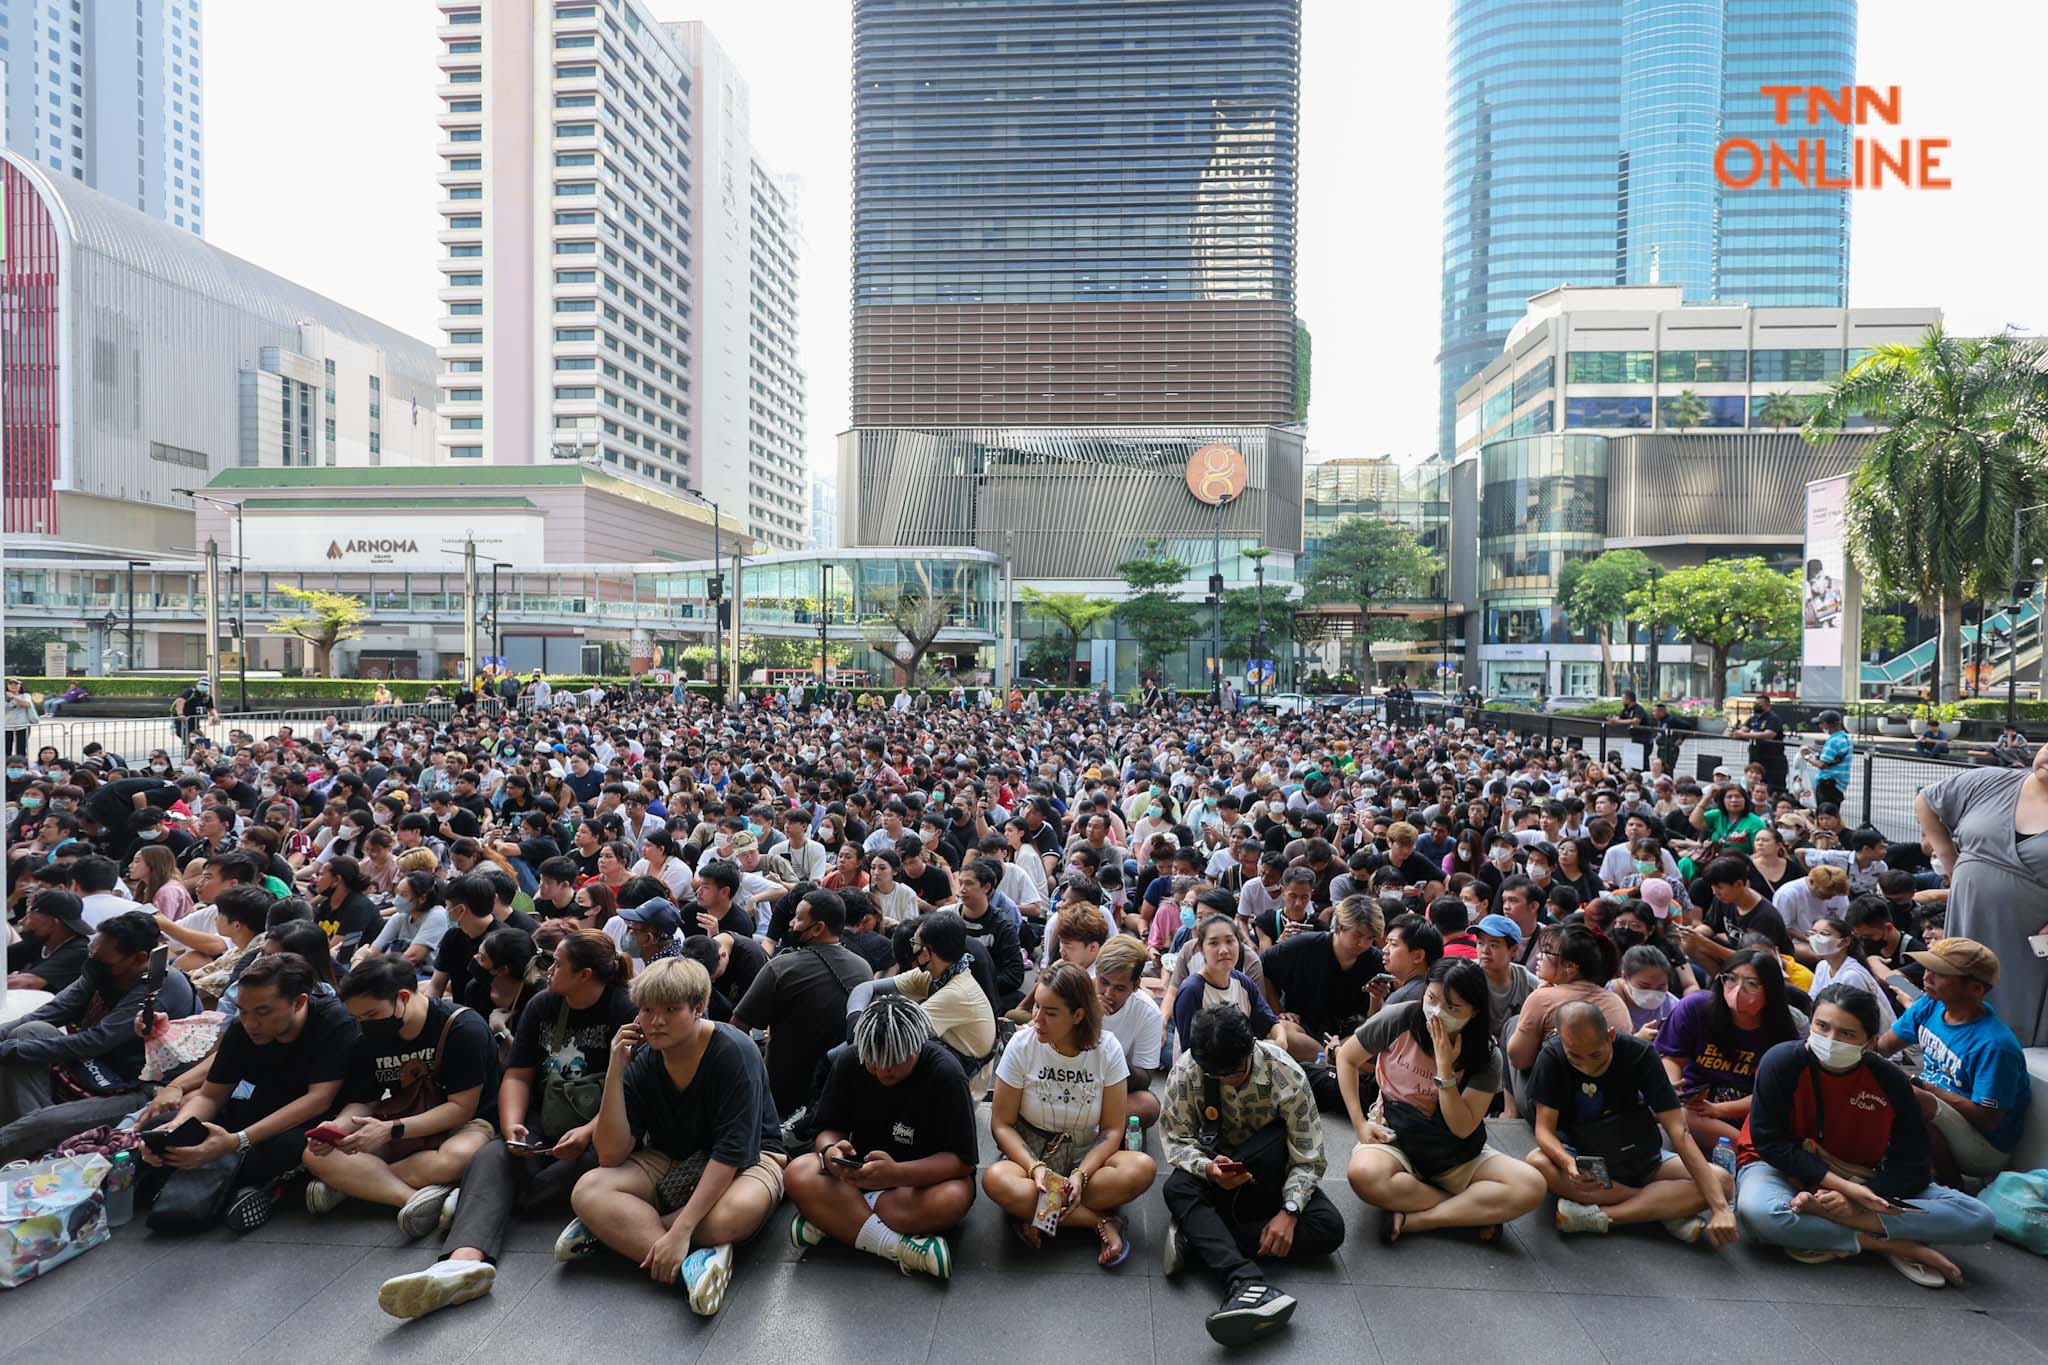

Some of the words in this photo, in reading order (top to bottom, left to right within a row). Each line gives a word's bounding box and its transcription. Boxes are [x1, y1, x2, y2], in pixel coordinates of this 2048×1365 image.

[345, 539, 419, 553] ARNOMA
[1696, 1056, 1732, 1071] NEON
[1038, 1066, 1094, 1084] JASPAL
[1850, 1091, 1887, 1106] California
